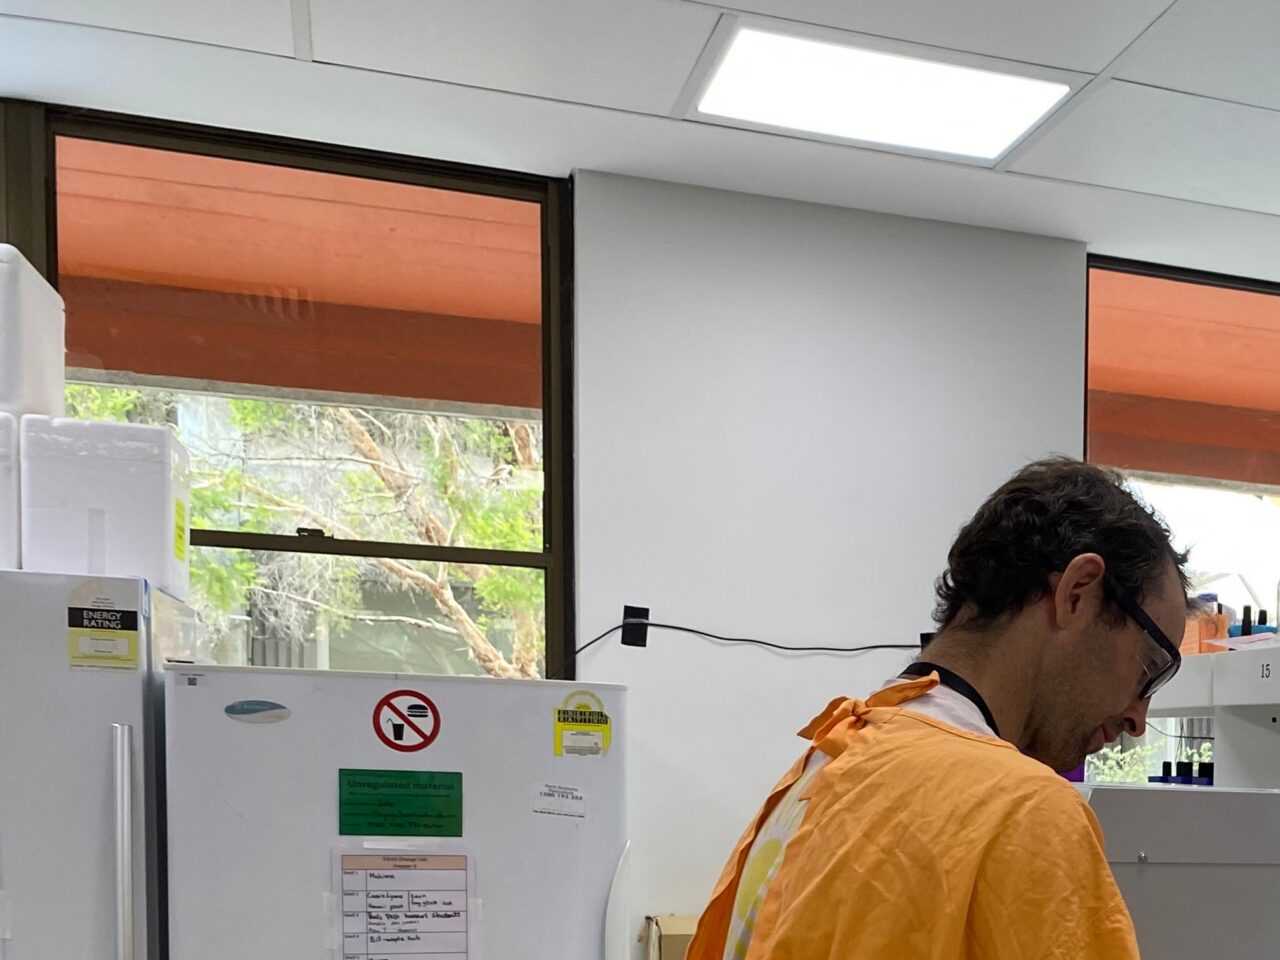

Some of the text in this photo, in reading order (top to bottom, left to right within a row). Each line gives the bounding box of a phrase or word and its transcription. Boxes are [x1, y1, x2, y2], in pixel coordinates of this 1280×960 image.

[83, 610, 122, 620] ENERGY
[83, 619, 122, 629] RATING
[1261, 663, 1271, 679] 15
[347, 779, 455, 791] Unregulated material
